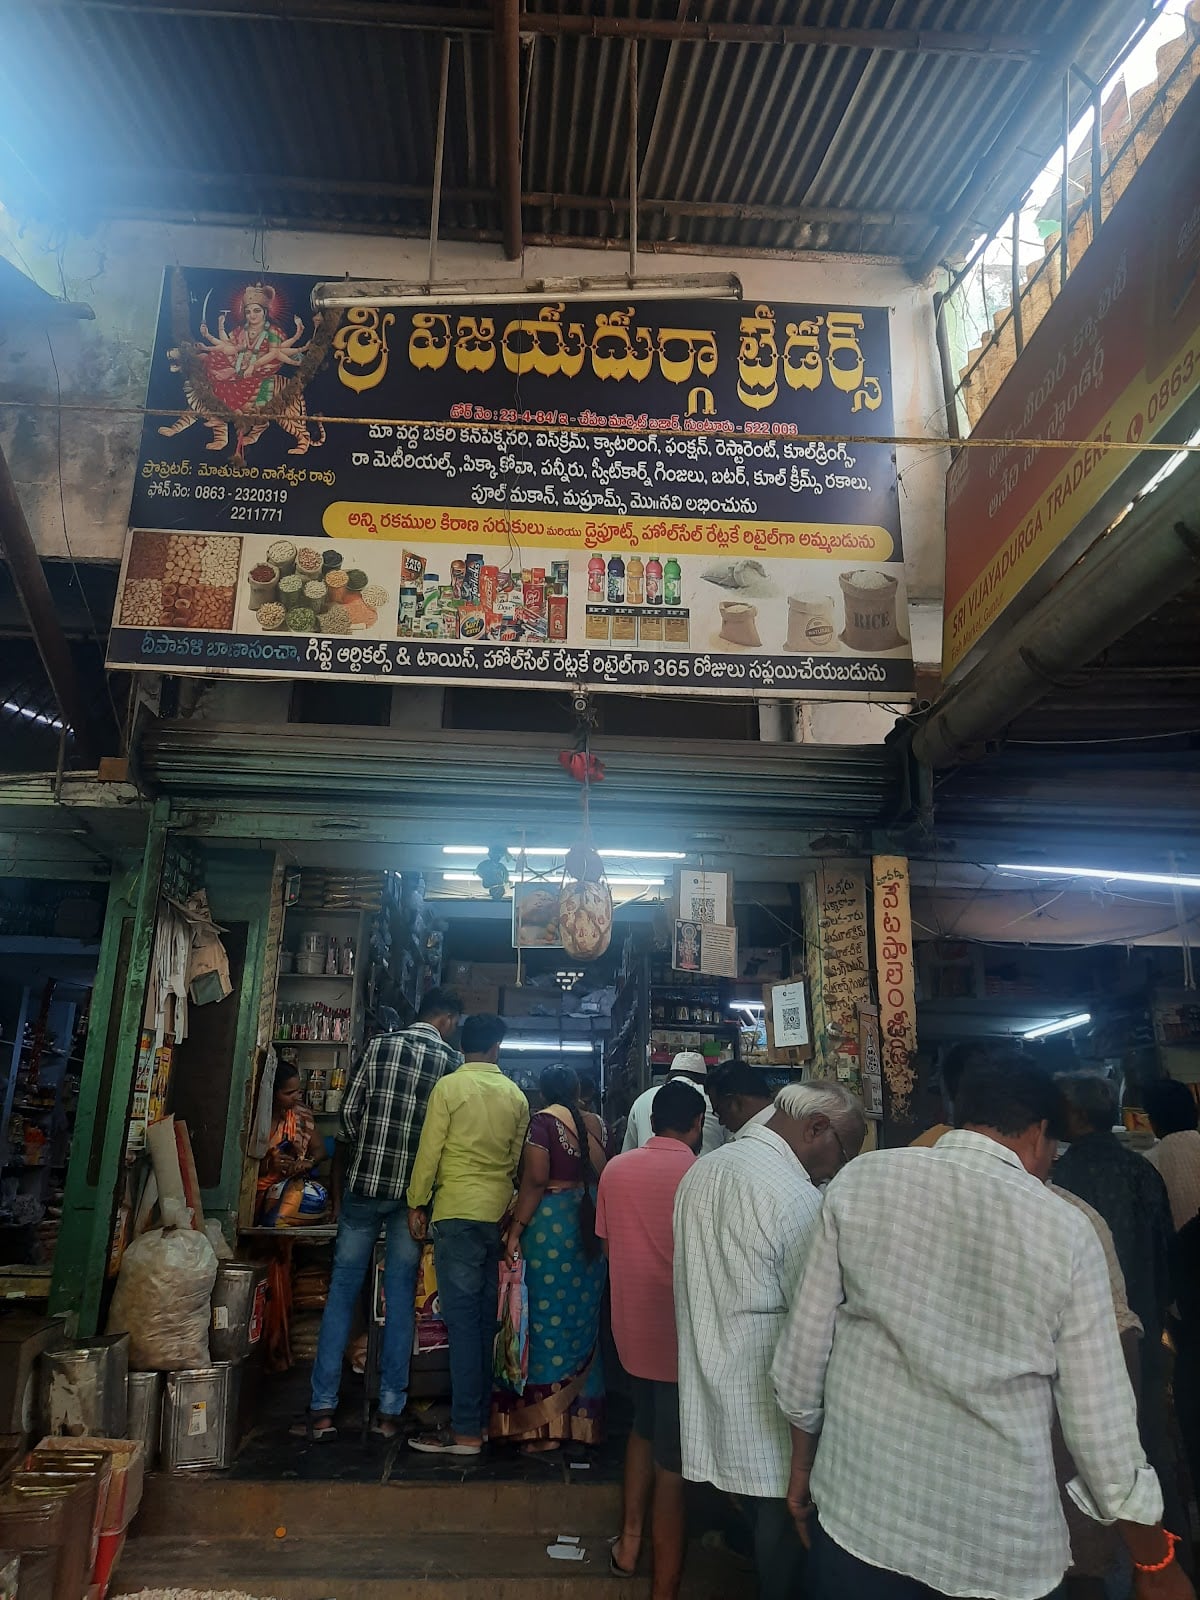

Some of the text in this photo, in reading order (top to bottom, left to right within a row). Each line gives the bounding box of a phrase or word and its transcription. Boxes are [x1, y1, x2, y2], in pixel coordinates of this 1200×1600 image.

[332, 307, 396, 395] శ్రీ
[744, 422, 769, 434] 522
[772, 423, 798, 435] 003
[309, 469, 336, 487] రావు
[195, 485, 225, 500] 0863
[234, 487, 288, 503] 2320319
[230, 506, 283, 522] 2211771
[348, 511, 378, 533] అన్ని
[380, 512, 437, 530] రకముల
[440, 512, 480, 532] కిరాణ
[483, 515, 544, 535] సరుకులు
[799, 531, 875, 553] అమ్మబడును
[953, 420, 1113, 639] SRI VIJAYADURGA TRADERS
[854, 611, 890, 630] RICE
[396, 647, 411, 665] &
[653, 659, 690, 677] 365
[693, 655, 746, 678] రోజులు
